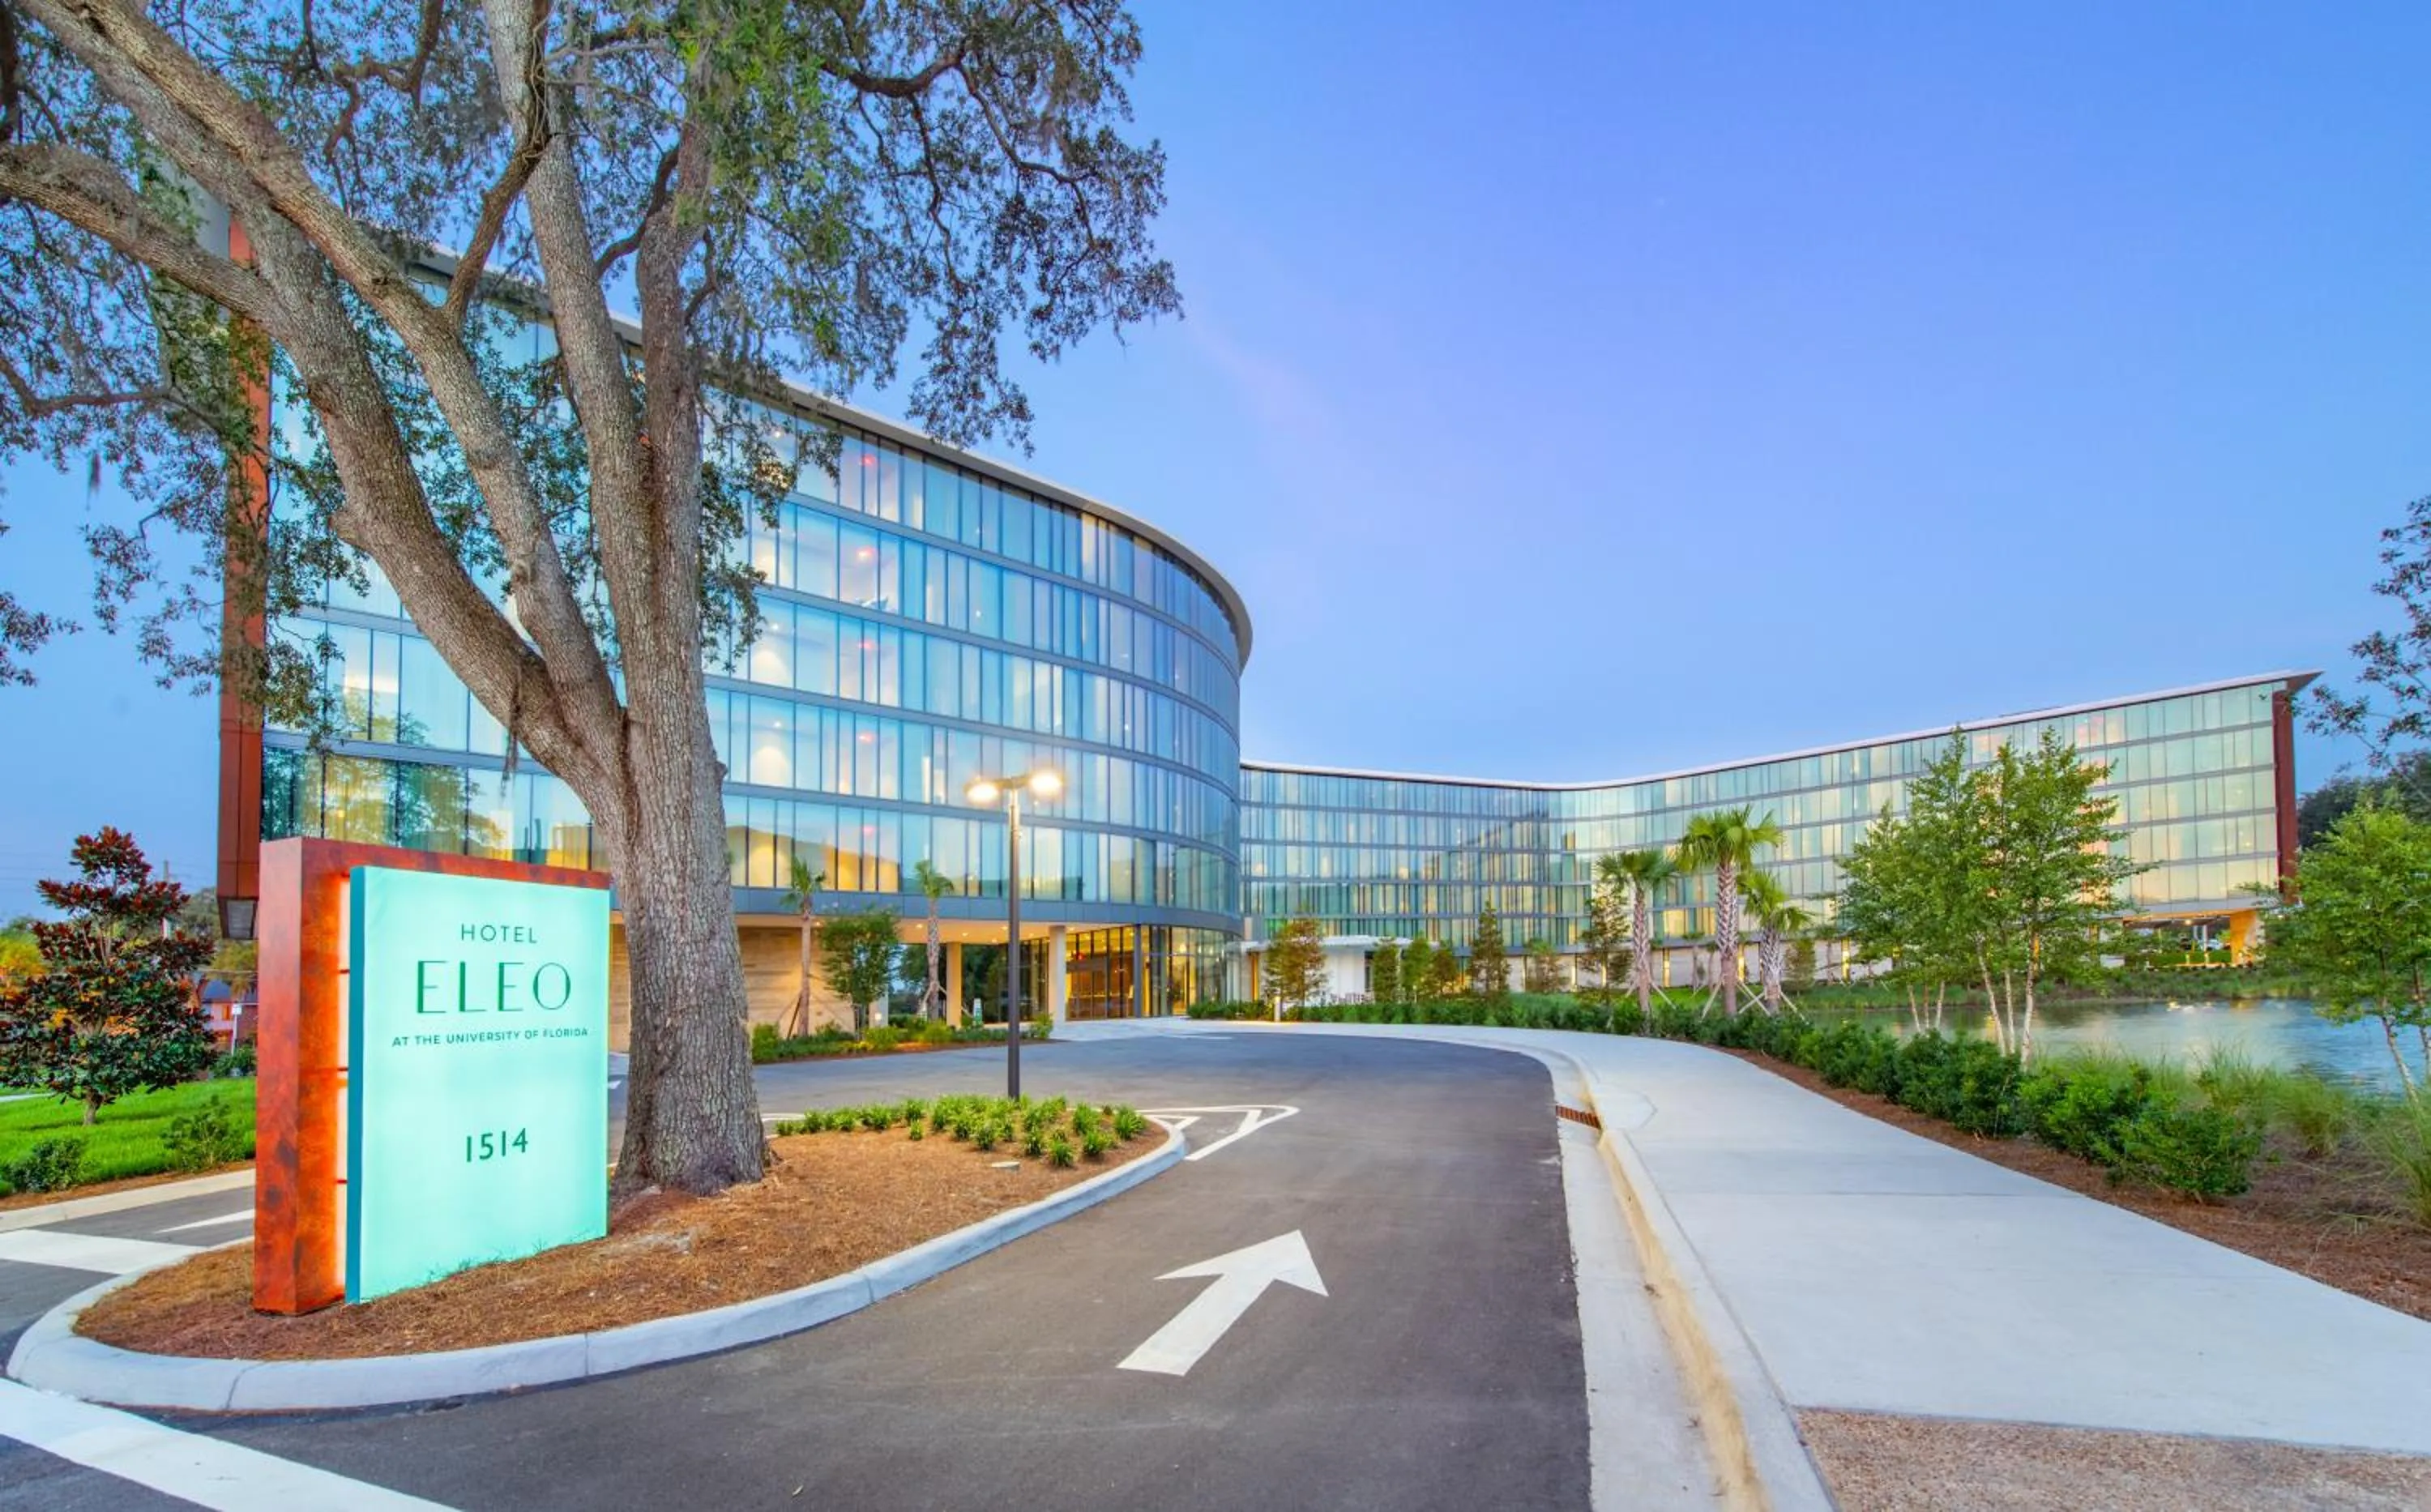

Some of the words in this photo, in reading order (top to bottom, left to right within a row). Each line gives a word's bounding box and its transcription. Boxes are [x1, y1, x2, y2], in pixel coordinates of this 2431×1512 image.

[460, 923, 537, 944] HOTEL
[417, 960, 571, 1014] ELEO
[391, 1036, 409, 1047] AT
[415, 1034, 441, 1044] THE
[446, 1030, 519, 1044] UNIVERSITY
[524, 1029, 539, 1039] OF
[543, 1027, 588, 1038] FLORIDA
[466, 1127, 528, 1163] 1514
